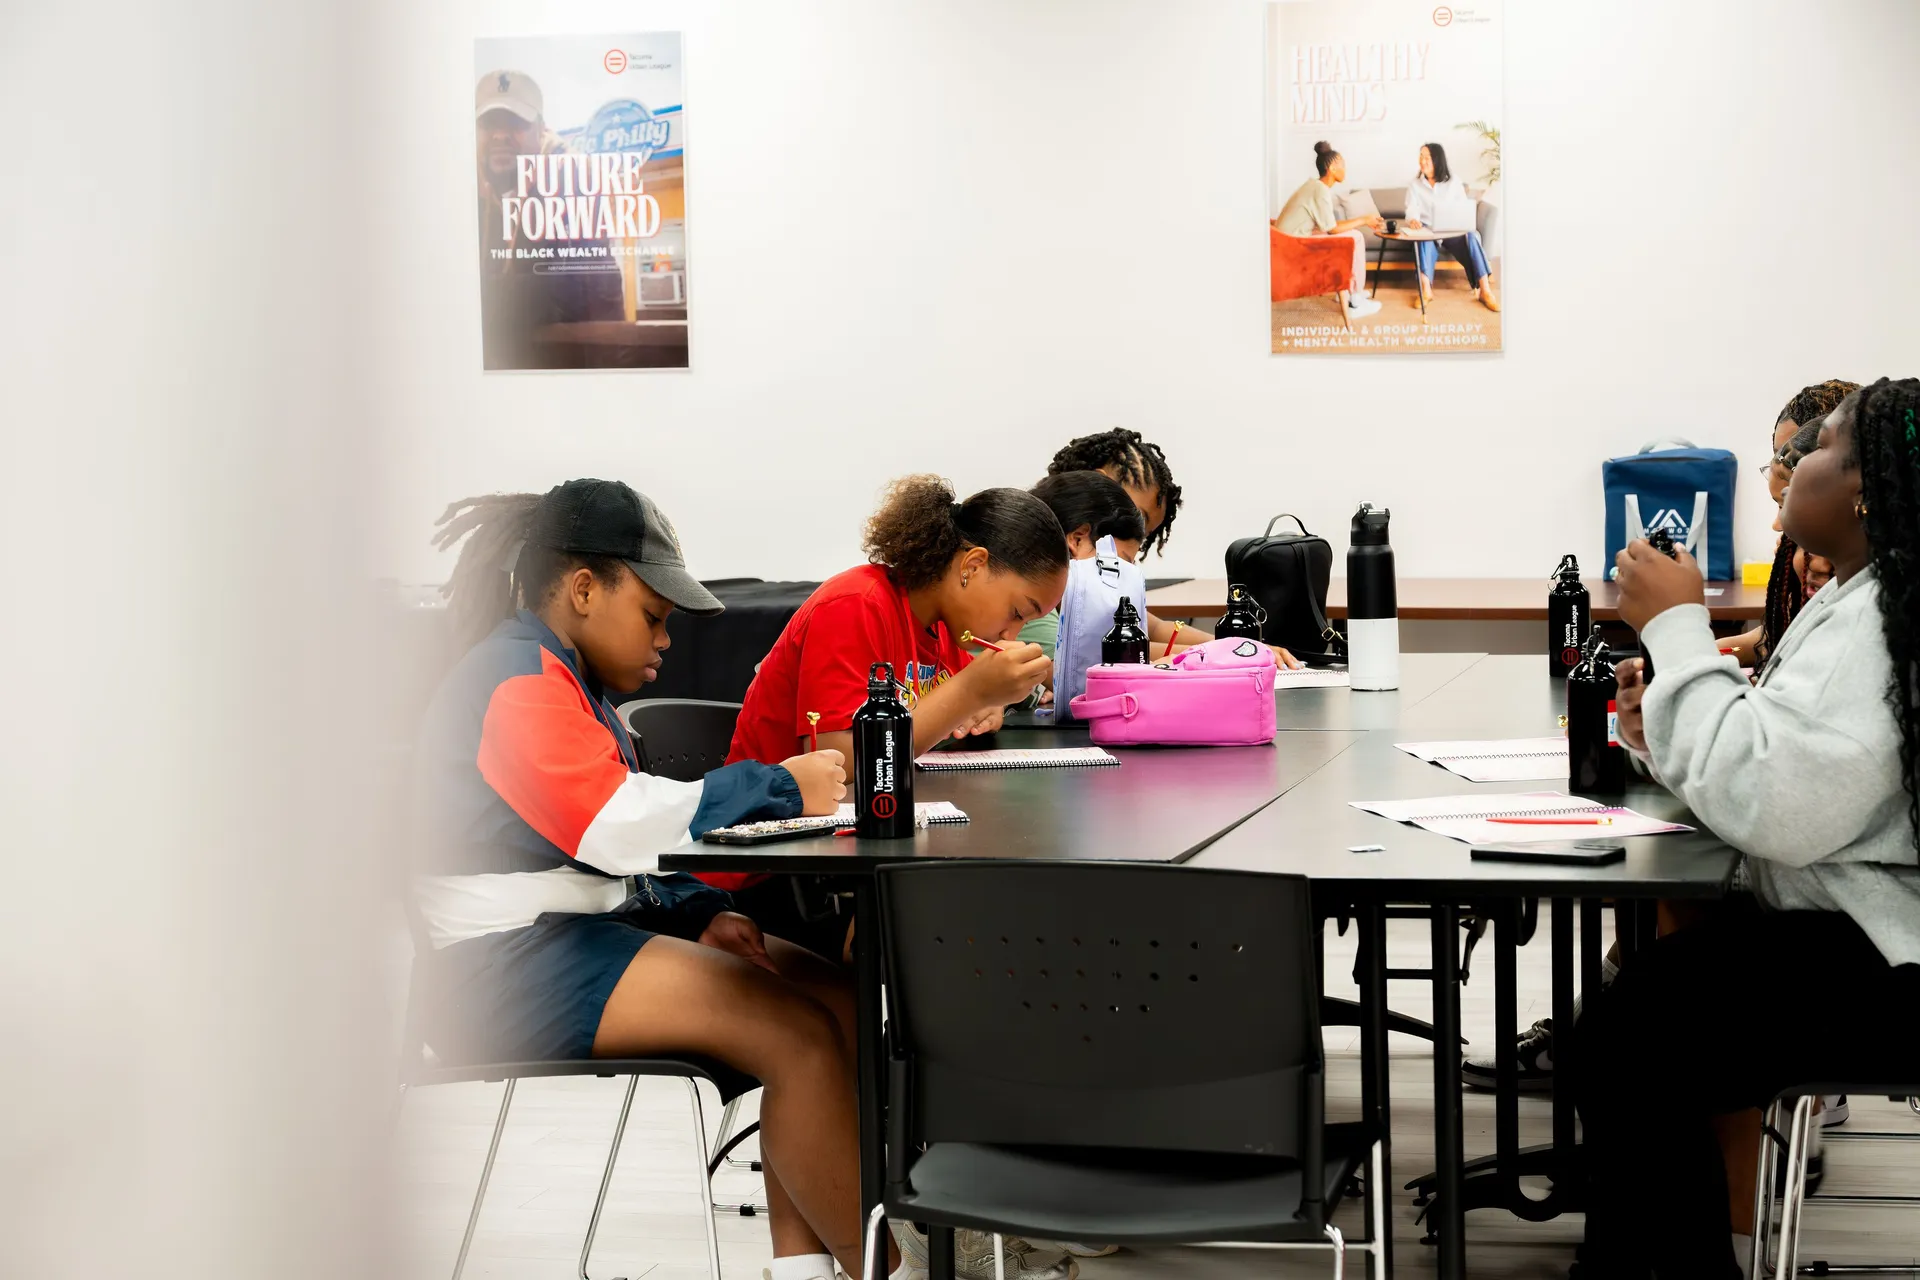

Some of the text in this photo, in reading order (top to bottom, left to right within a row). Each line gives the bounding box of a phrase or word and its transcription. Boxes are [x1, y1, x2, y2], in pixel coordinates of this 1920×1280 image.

[1293, 41, 1432, 85] HEALTHY
[1292, 83, 1387, 124] MINDS
[602, 119, 670, 150] Philly
[516, 152, 644, 197] FUTURE
[502, 195, 661, 241] FORWARD
[490, 246, 675, 259] THE BLACK WEALTH EXCHANGE
[1281, 324, 1482, 336] INDIVIDUAL & GROUP THERAPY
[1293, 337, 1343, 347] MENTAL
[1350, 336, 1399, 346] HEALTH
[1404, 335, 1487, 345] WORKSHOPS
[1571, 605, 1579, 627] League
[874, 758, 883, 792] Tacoma
[884, 730, 895, 792] Urban League
